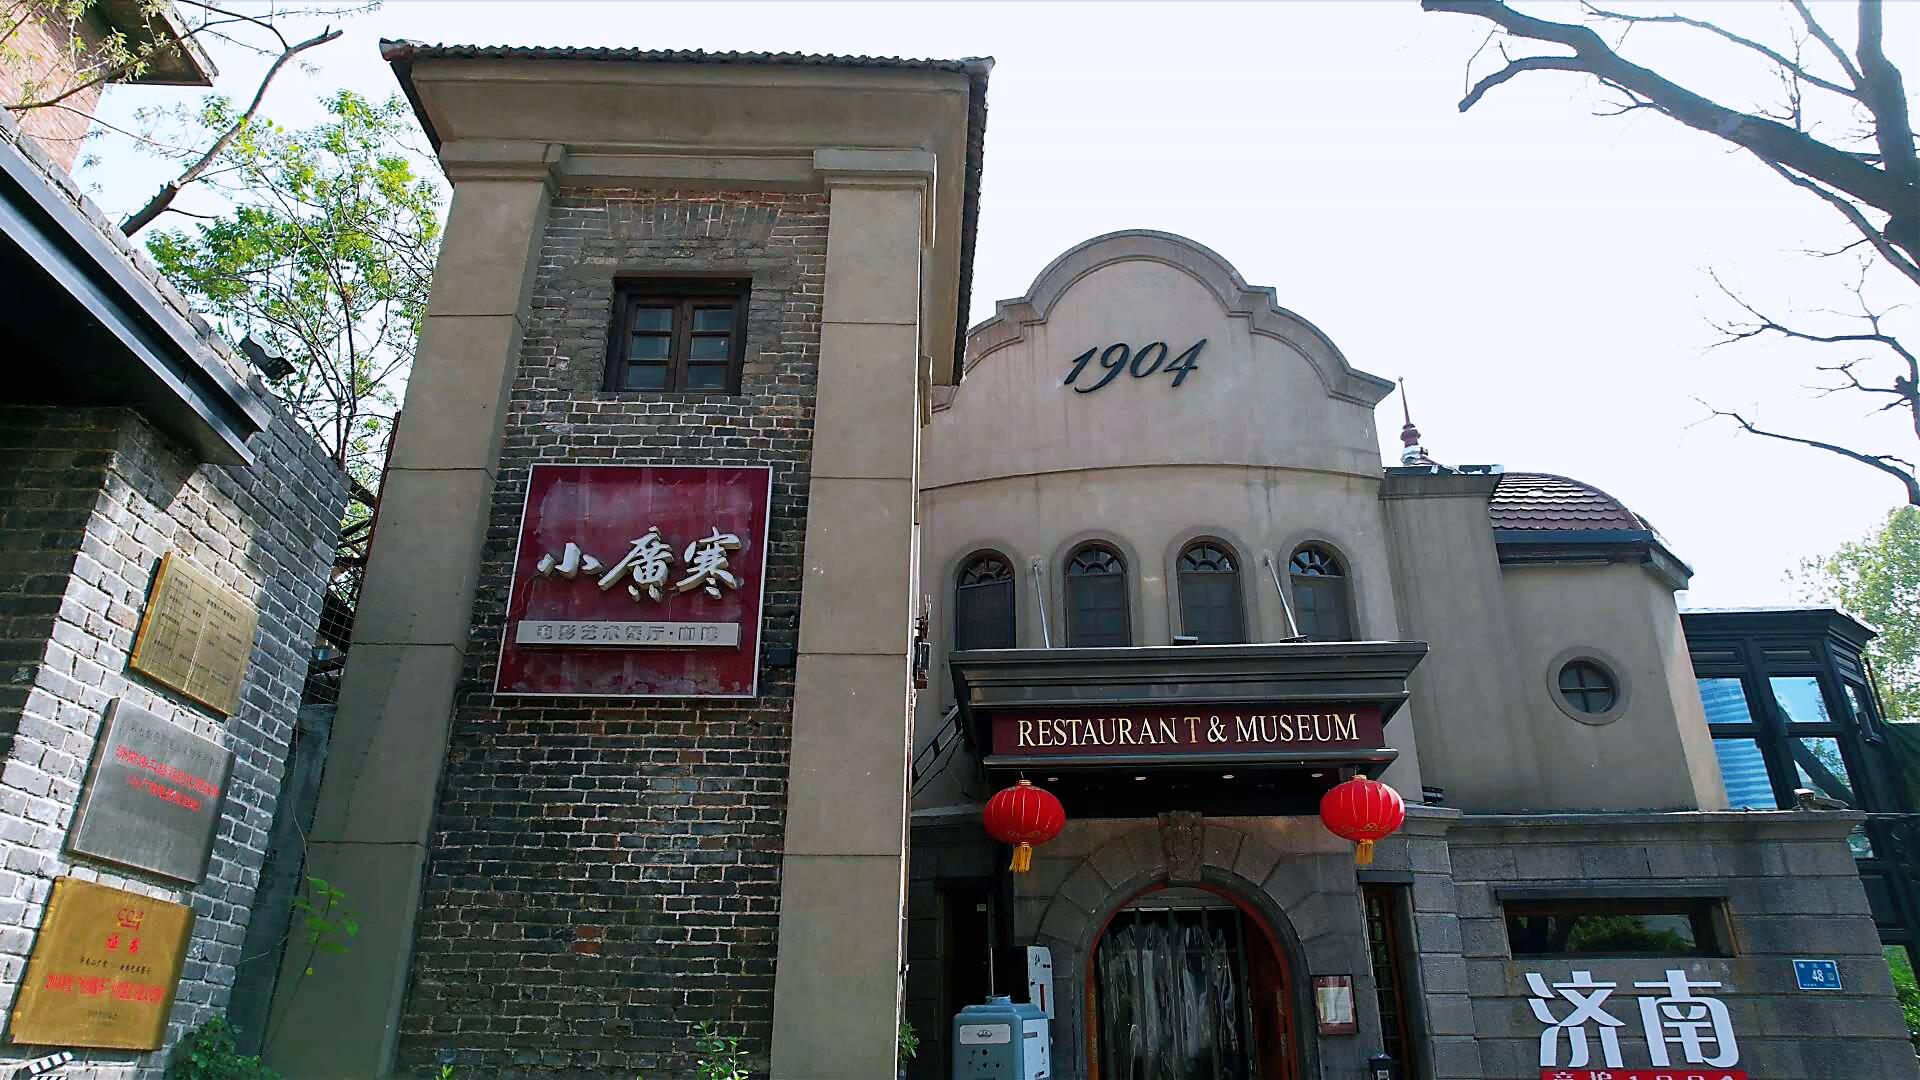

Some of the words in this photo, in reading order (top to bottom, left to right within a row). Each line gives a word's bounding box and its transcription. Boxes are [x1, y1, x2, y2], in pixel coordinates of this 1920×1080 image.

[1063, 338, 1208, 394] 1904
[1207, 714, 1229, 743] &
[1235, 713, 1360, 744] MUSEUM
[1525, 969, 1740, 1069] 济南
